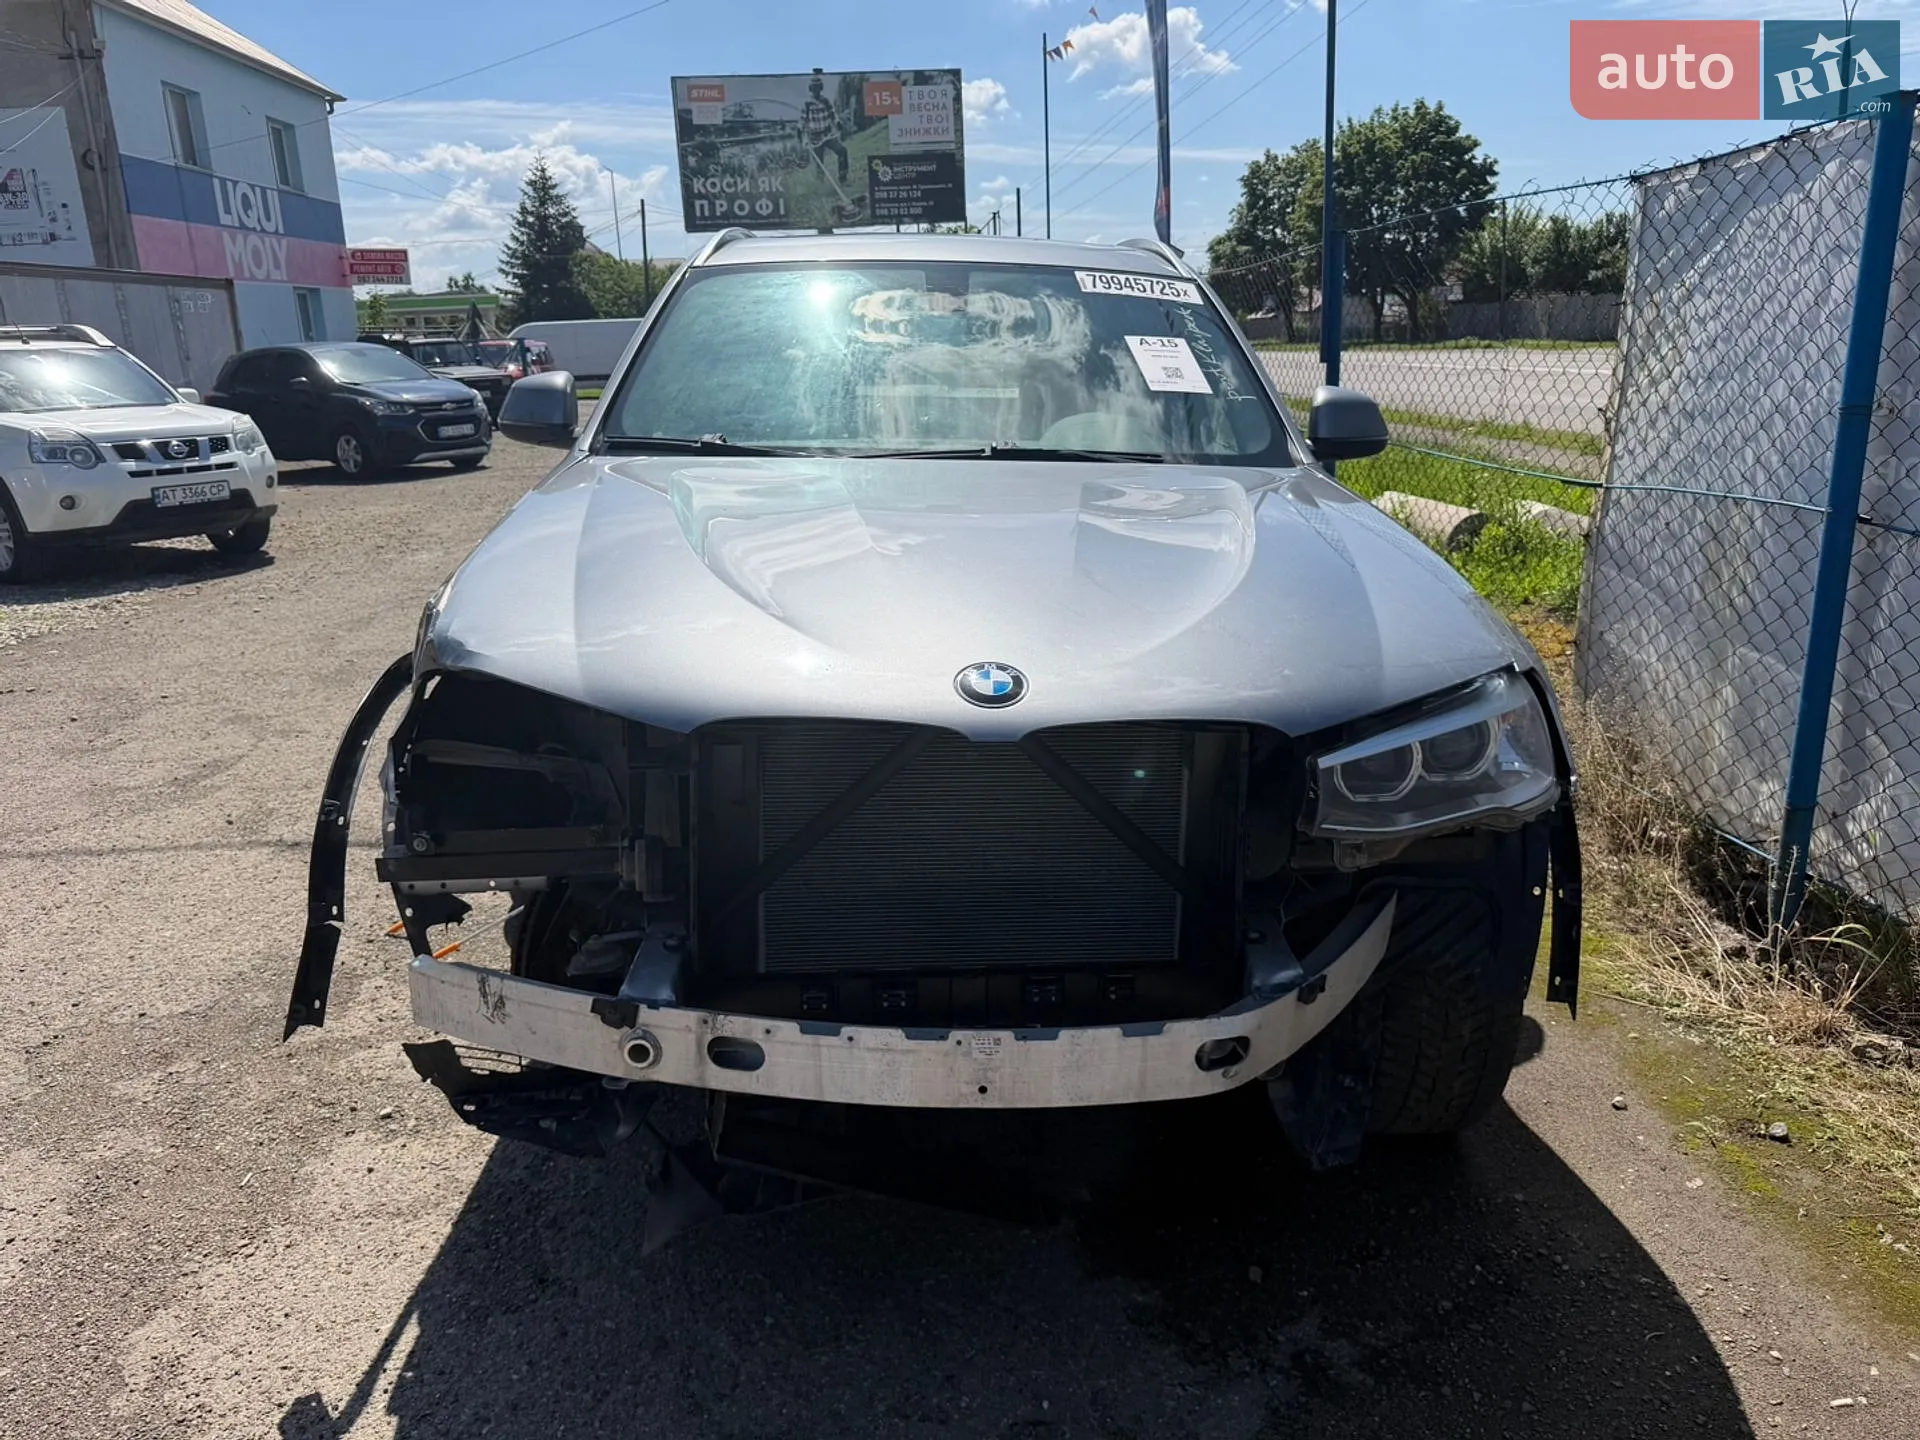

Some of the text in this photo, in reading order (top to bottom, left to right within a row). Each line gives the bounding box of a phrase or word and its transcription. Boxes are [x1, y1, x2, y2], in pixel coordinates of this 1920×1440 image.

[907, 88, 948, 101] ТВОЯ
[908, 102, 948, 112] ВЕСНА
[897, 126, 950, 138] ЗНИЖКИ
[692, 176, 784, 193] КОСИ ЯК
[212, 177, 285, 234] LIQUI
[694, 198, 785, 217] ПРОФІ
[221, 230, 288, 280] MOLY
[1139, 337, 1179, 348] A-15
[162, 484, 225, 501] AT 3366 CP
